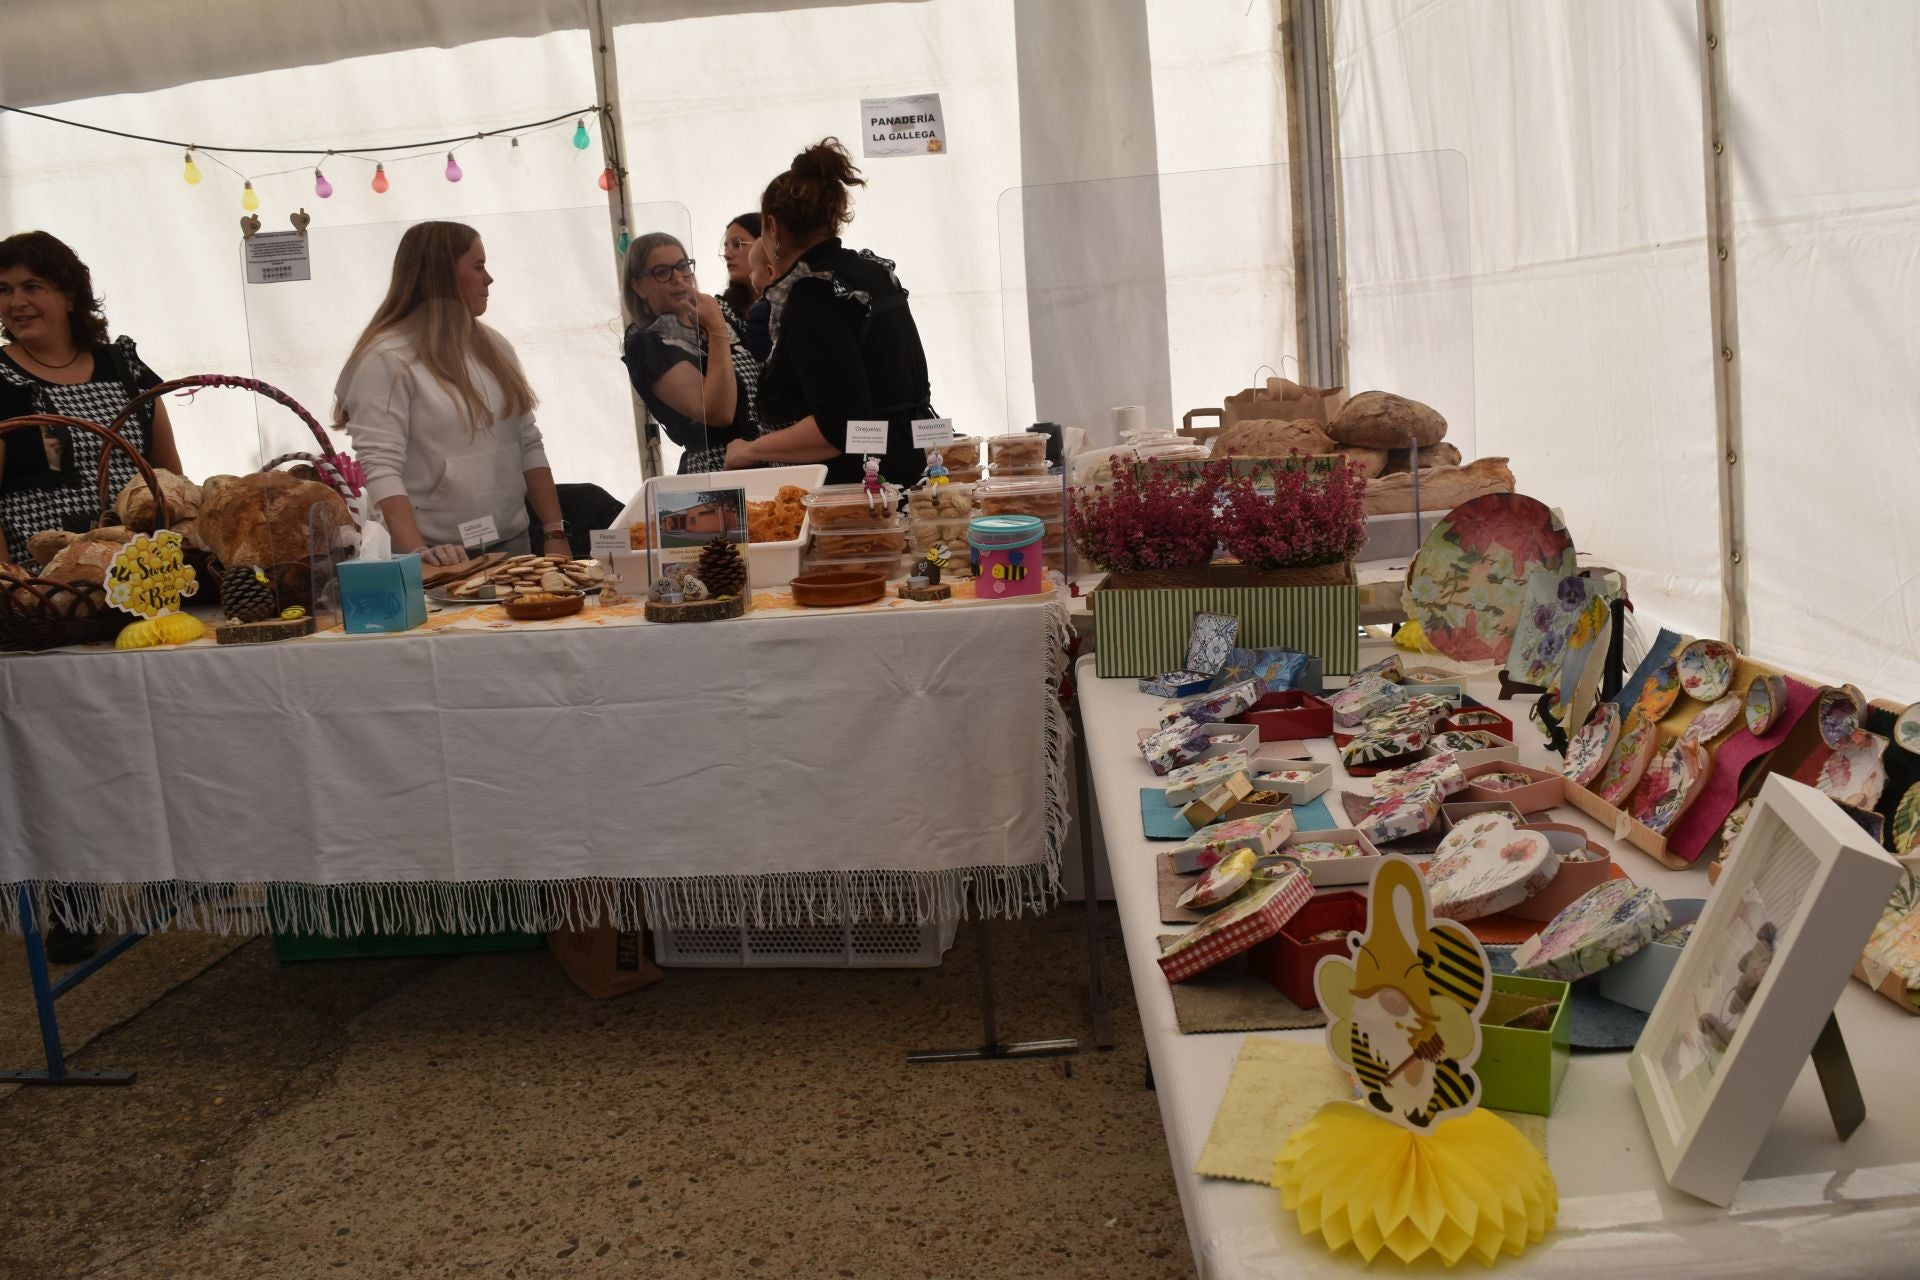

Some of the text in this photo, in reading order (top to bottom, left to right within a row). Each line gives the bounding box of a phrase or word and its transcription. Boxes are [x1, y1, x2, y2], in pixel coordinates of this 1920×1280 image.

[871, 112, 936, 126] PANADERÍA
[872, 130, 936, 142] LA GALLEGA
[137, 556, 180, 580] Sweet
[148, 586, 177, 610] Bee
